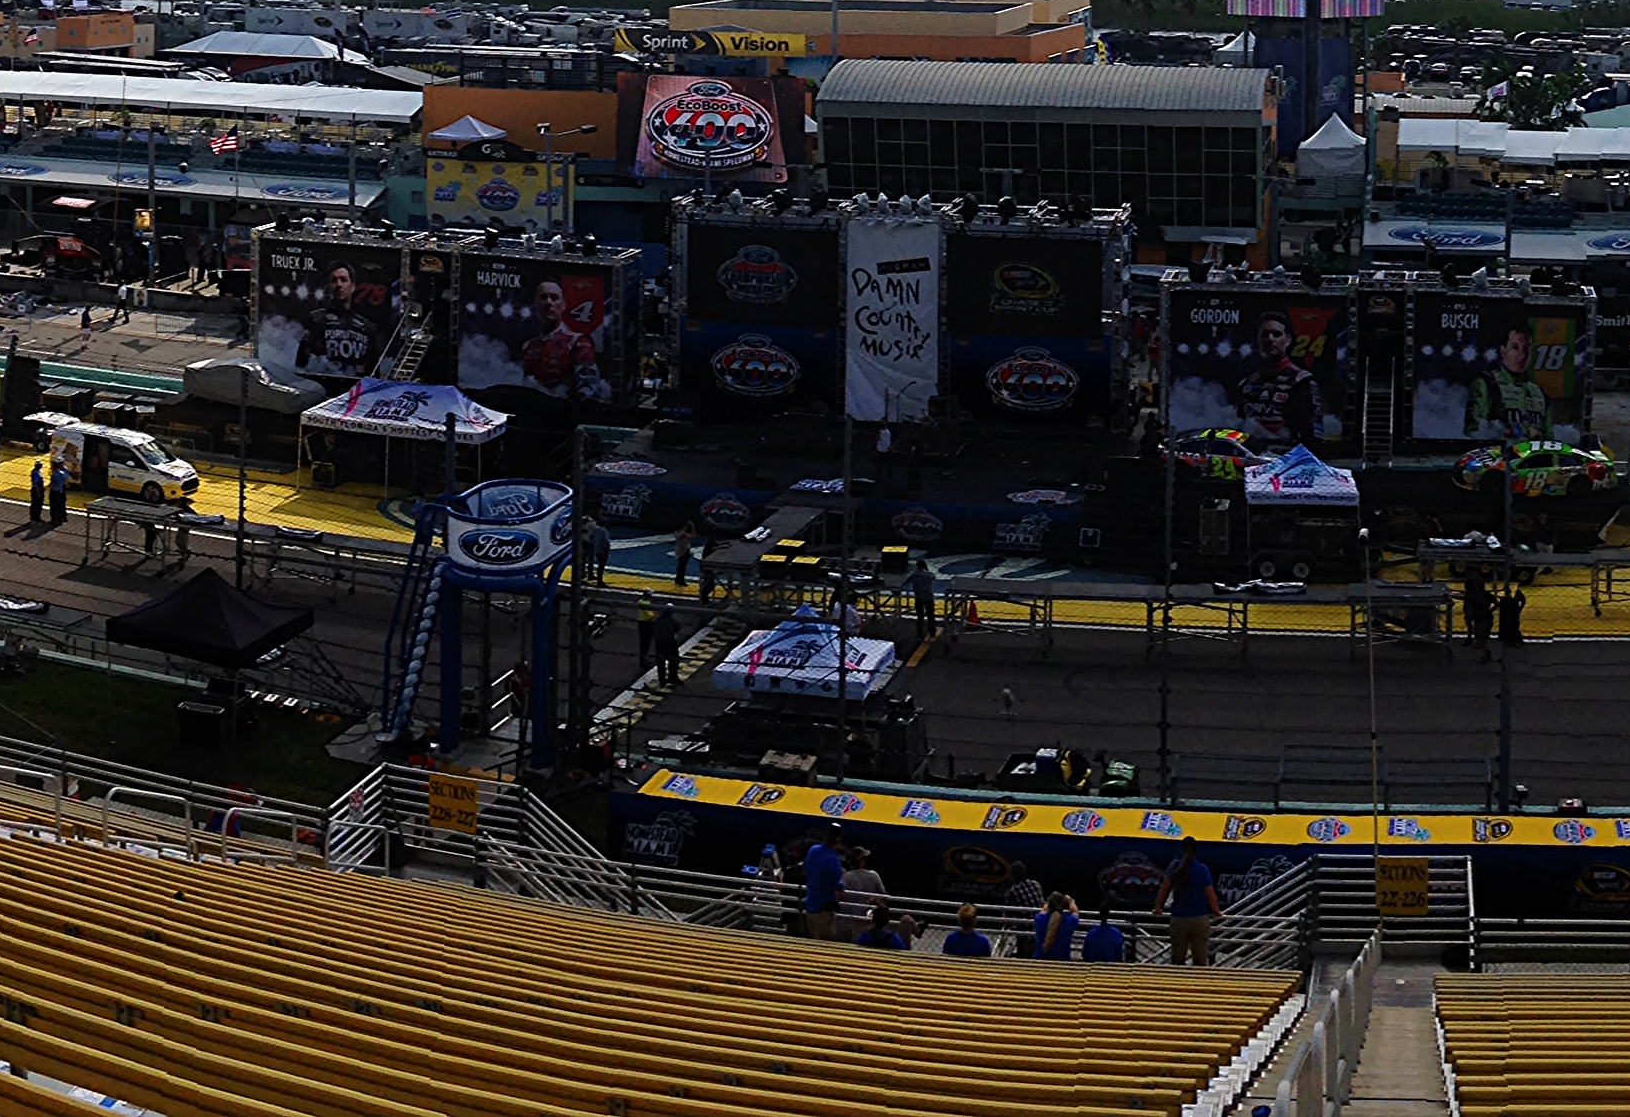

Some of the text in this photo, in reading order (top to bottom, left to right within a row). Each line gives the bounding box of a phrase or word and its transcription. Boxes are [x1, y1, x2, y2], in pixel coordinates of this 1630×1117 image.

[642, 35, 790, 52] Sprint Vision
[676, 99, 743, 113] EcoBoost
[672, 111, 759, 148] 400
[663, 150, 721, 168] HOMESTEAD-MAMI
[271, 254, 318, 272] TRUEX JR.
[476, 270, 521, 289] HARVICK
[852, 268, 921, 304] DAMN
[569, 300, 595, 324] 4
[1190, 308, 1240, 325] GORDON
[1441, 313, 1479, 330] BUSCH
[327, 339, 368, 360] ROW
[730, 349, 780, 361] EcoBoost
[1290, 334, 1328, 359] 24
[1534, 344, 1567, 370] 18
[726, 359, 788, 385] 400
[1007, 363, 1059, 374] EcoBoost
[1001, 372, 1069, 400] 400
[368, 406, 412, 419] MIAMI
[374, 398, 418, 413] HOMESTEAD
[1529, 439, 1563, 452] 18
[1211, 456, 1239, 480] 24
[1525, 471, 1547, 490] 18
[473, 532, 525, 559] Ford
[764, 656, 805, 666] MIAMI
[769, 647, 810, 660] HOMESTEAD
[430, 781, 477, 802] SECTIONS
[431, 805, 478, 829] 228-227
[1380, 864, 1427, 881] SECTIONS
